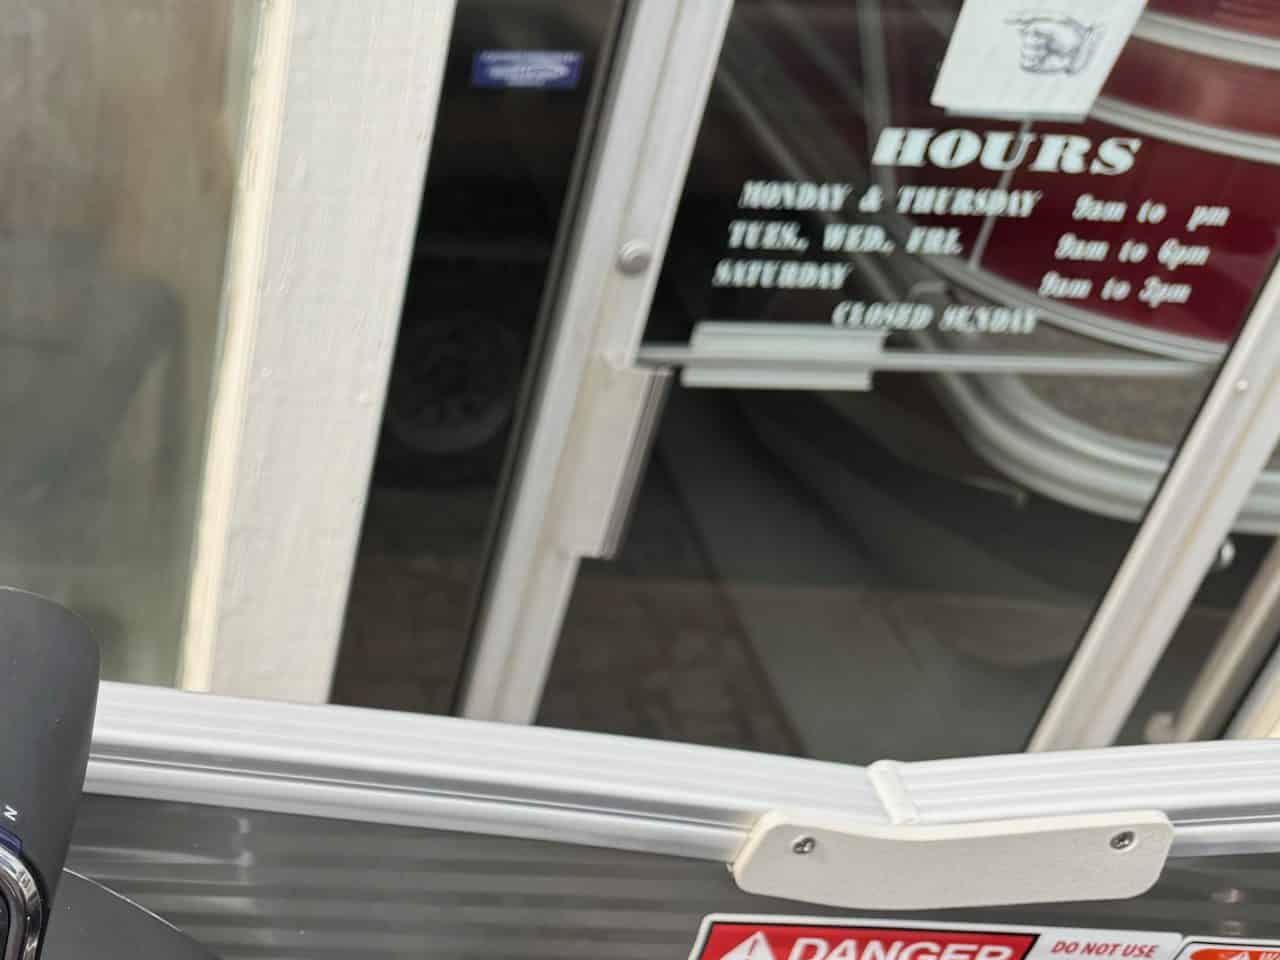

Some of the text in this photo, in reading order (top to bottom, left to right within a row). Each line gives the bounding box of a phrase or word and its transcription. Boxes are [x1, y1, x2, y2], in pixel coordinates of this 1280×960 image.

[872, 126, 1142, 176] HOURS
[738, 180, 1042, 217] MONDAY & THURSDAY
[1137, 200, 1166, 224] to
[1118, 240, 1148, 263] to
[711, 258, 853, 290] SATURDAY
[1101, 277, 1131, 301] to
[831, 301, 1041, 334] CLOSED SUNDAY
[3, 805, 19, 822] N
[1051, 941, 1159, 959] DO NOT USE
